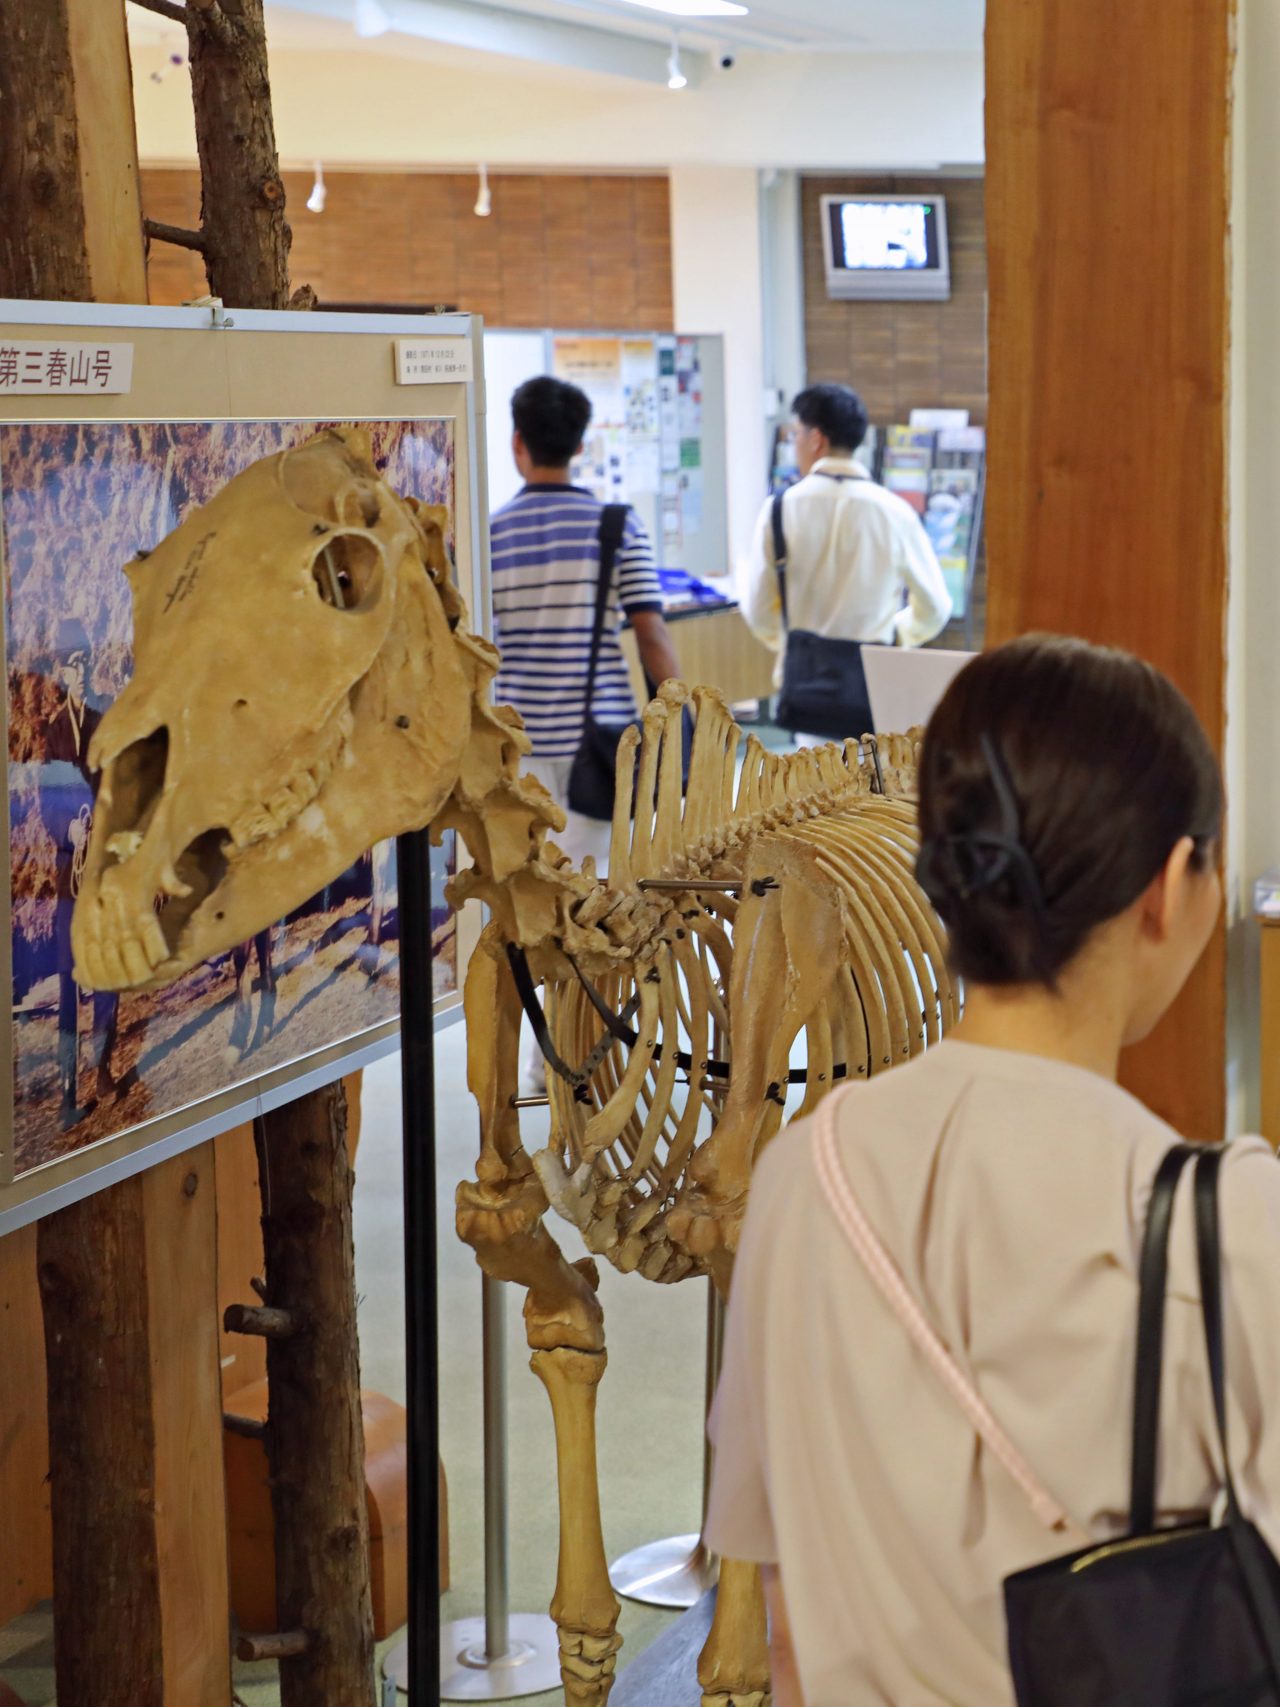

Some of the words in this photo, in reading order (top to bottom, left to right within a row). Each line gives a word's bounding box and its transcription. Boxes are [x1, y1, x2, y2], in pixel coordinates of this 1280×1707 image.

[0, 347, 112, 388] 第三春山号
